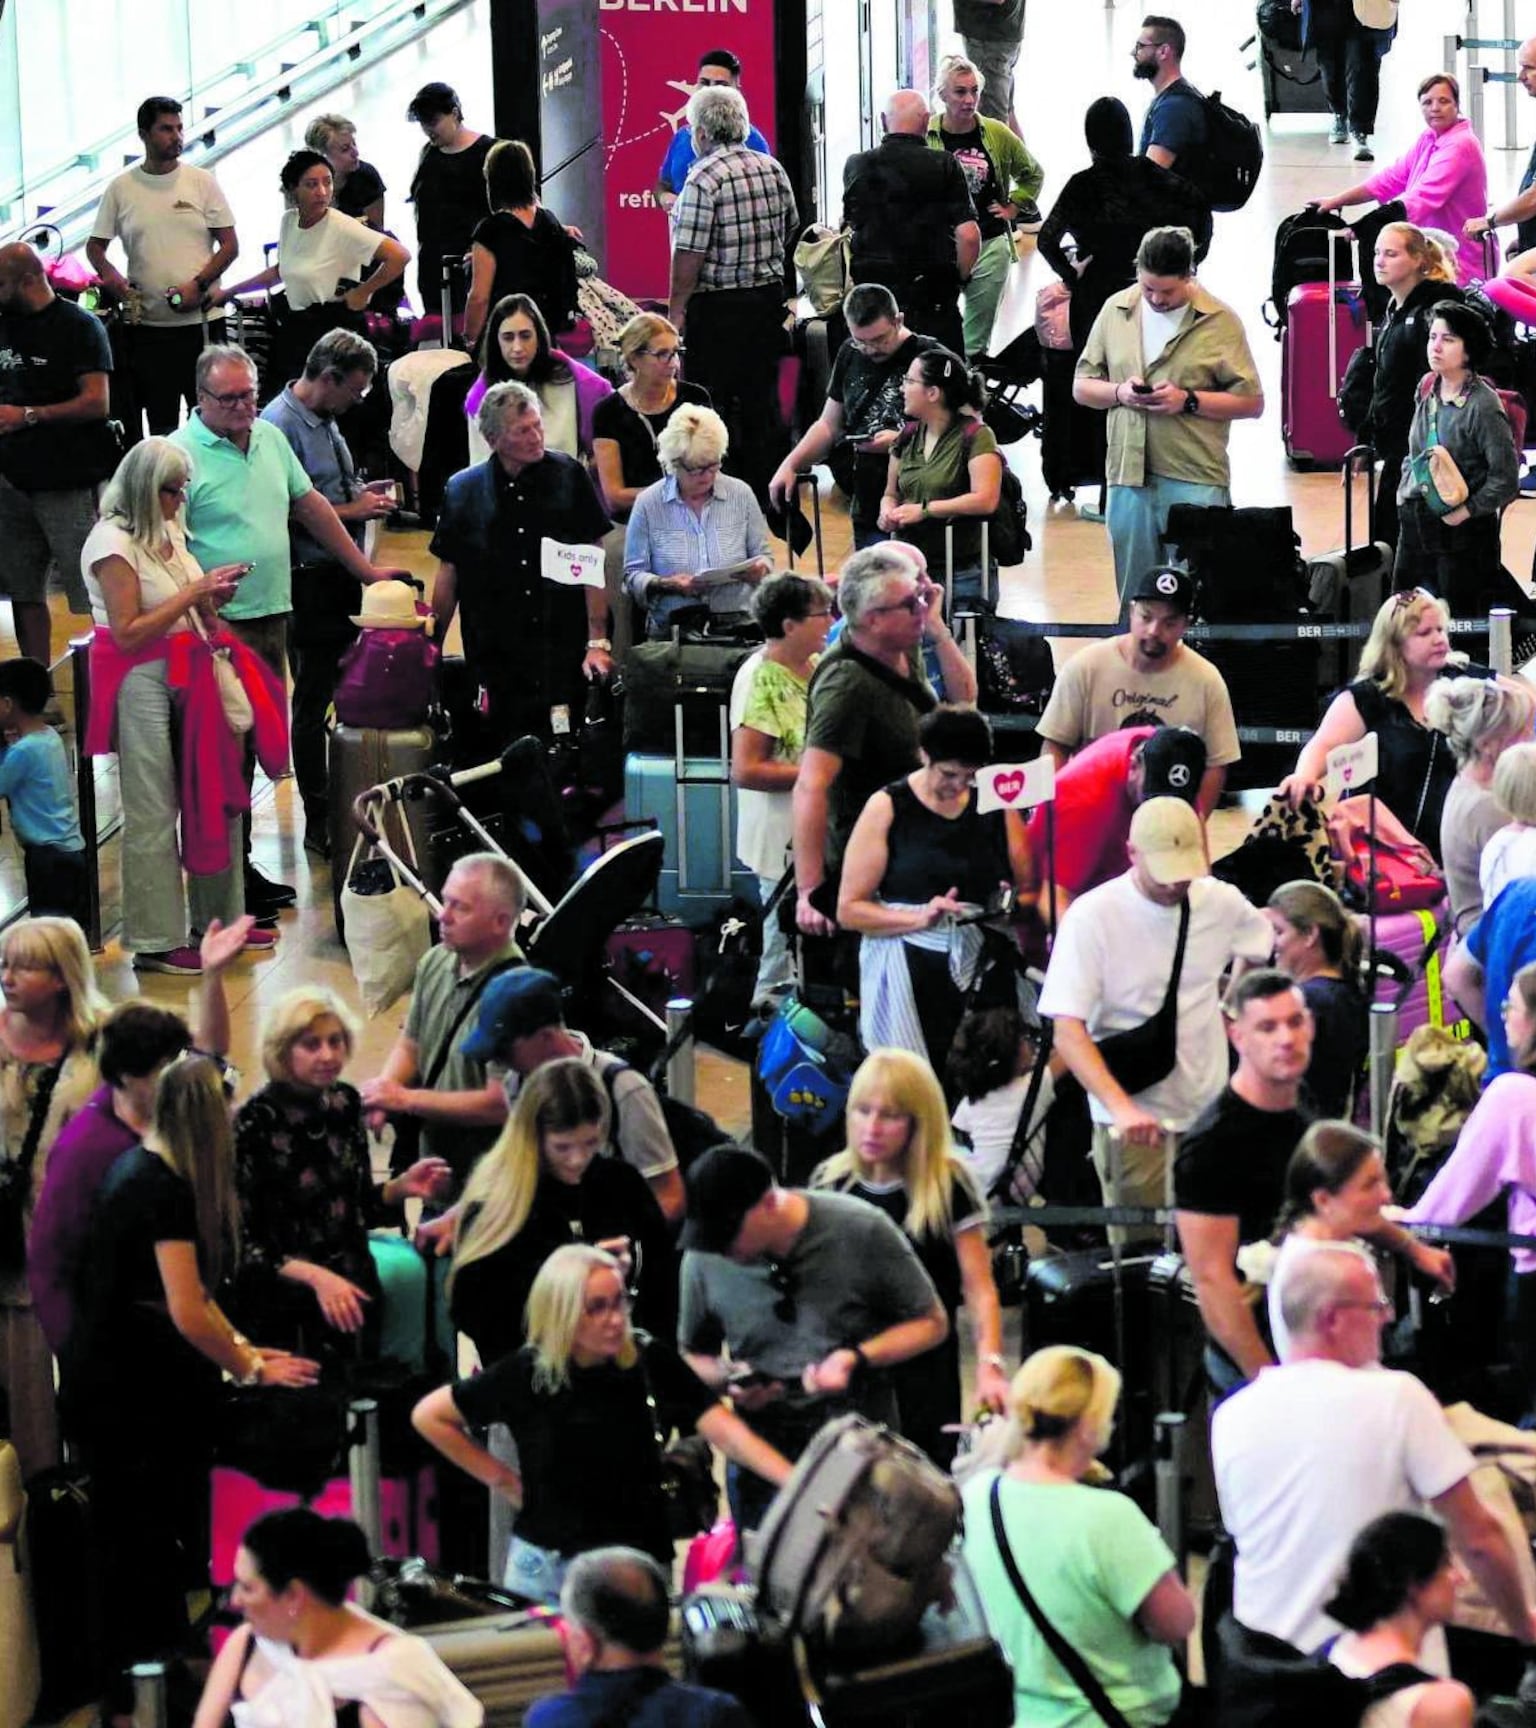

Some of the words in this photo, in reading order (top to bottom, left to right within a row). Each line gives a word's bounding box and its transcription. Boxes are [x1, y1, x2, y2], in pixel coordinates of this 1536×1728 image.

[1298, 626, 1322, 638] BER
[1449, 620, 1473, 633] BER
[1112, 689, 1178, 708] Original
[1276, 730, 1301, 743] BER
